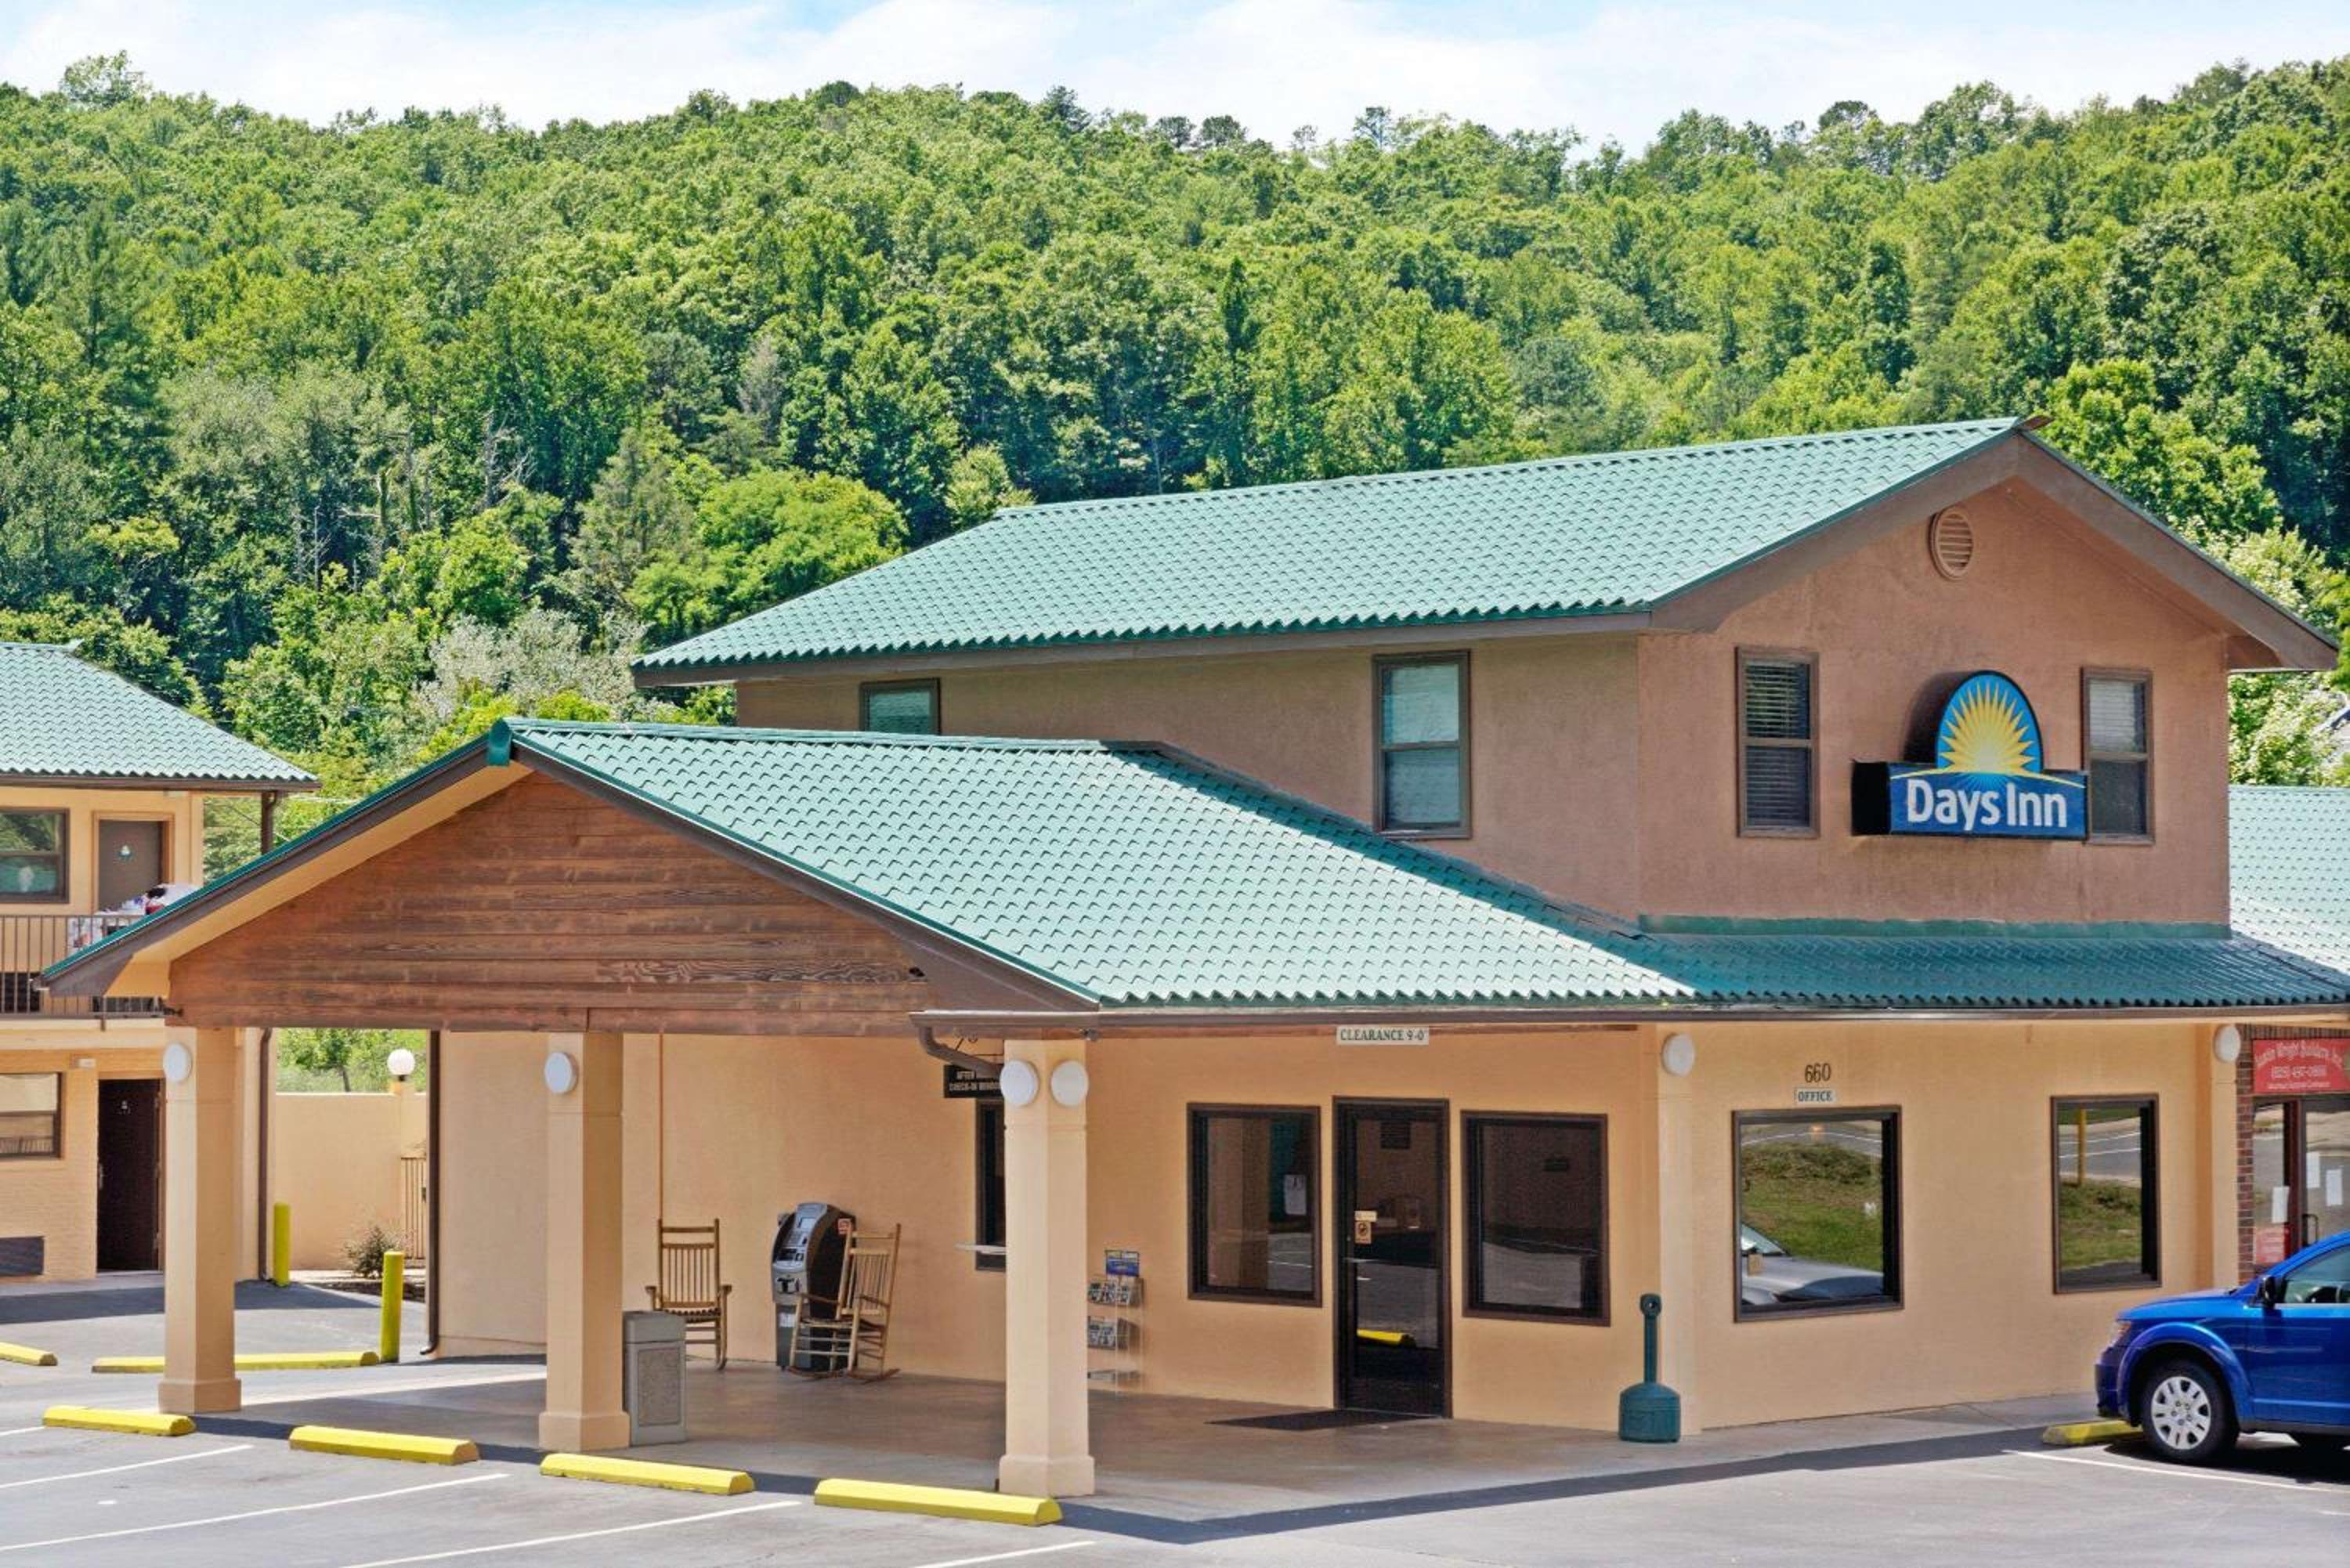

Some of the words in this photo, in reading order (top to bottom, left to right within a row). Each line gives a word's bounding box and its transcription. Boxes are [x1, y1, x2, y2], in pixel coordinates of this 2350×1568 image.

[1907, 779, 2001, 831] Days
[2007, 782, 2067, 828] Inn
[1340, 1028, 1404, 1041] CLEARANCE
[1805, 1062, 1831, 1082] 660
[1798, 1090, 1833, 1102] OFFICE
